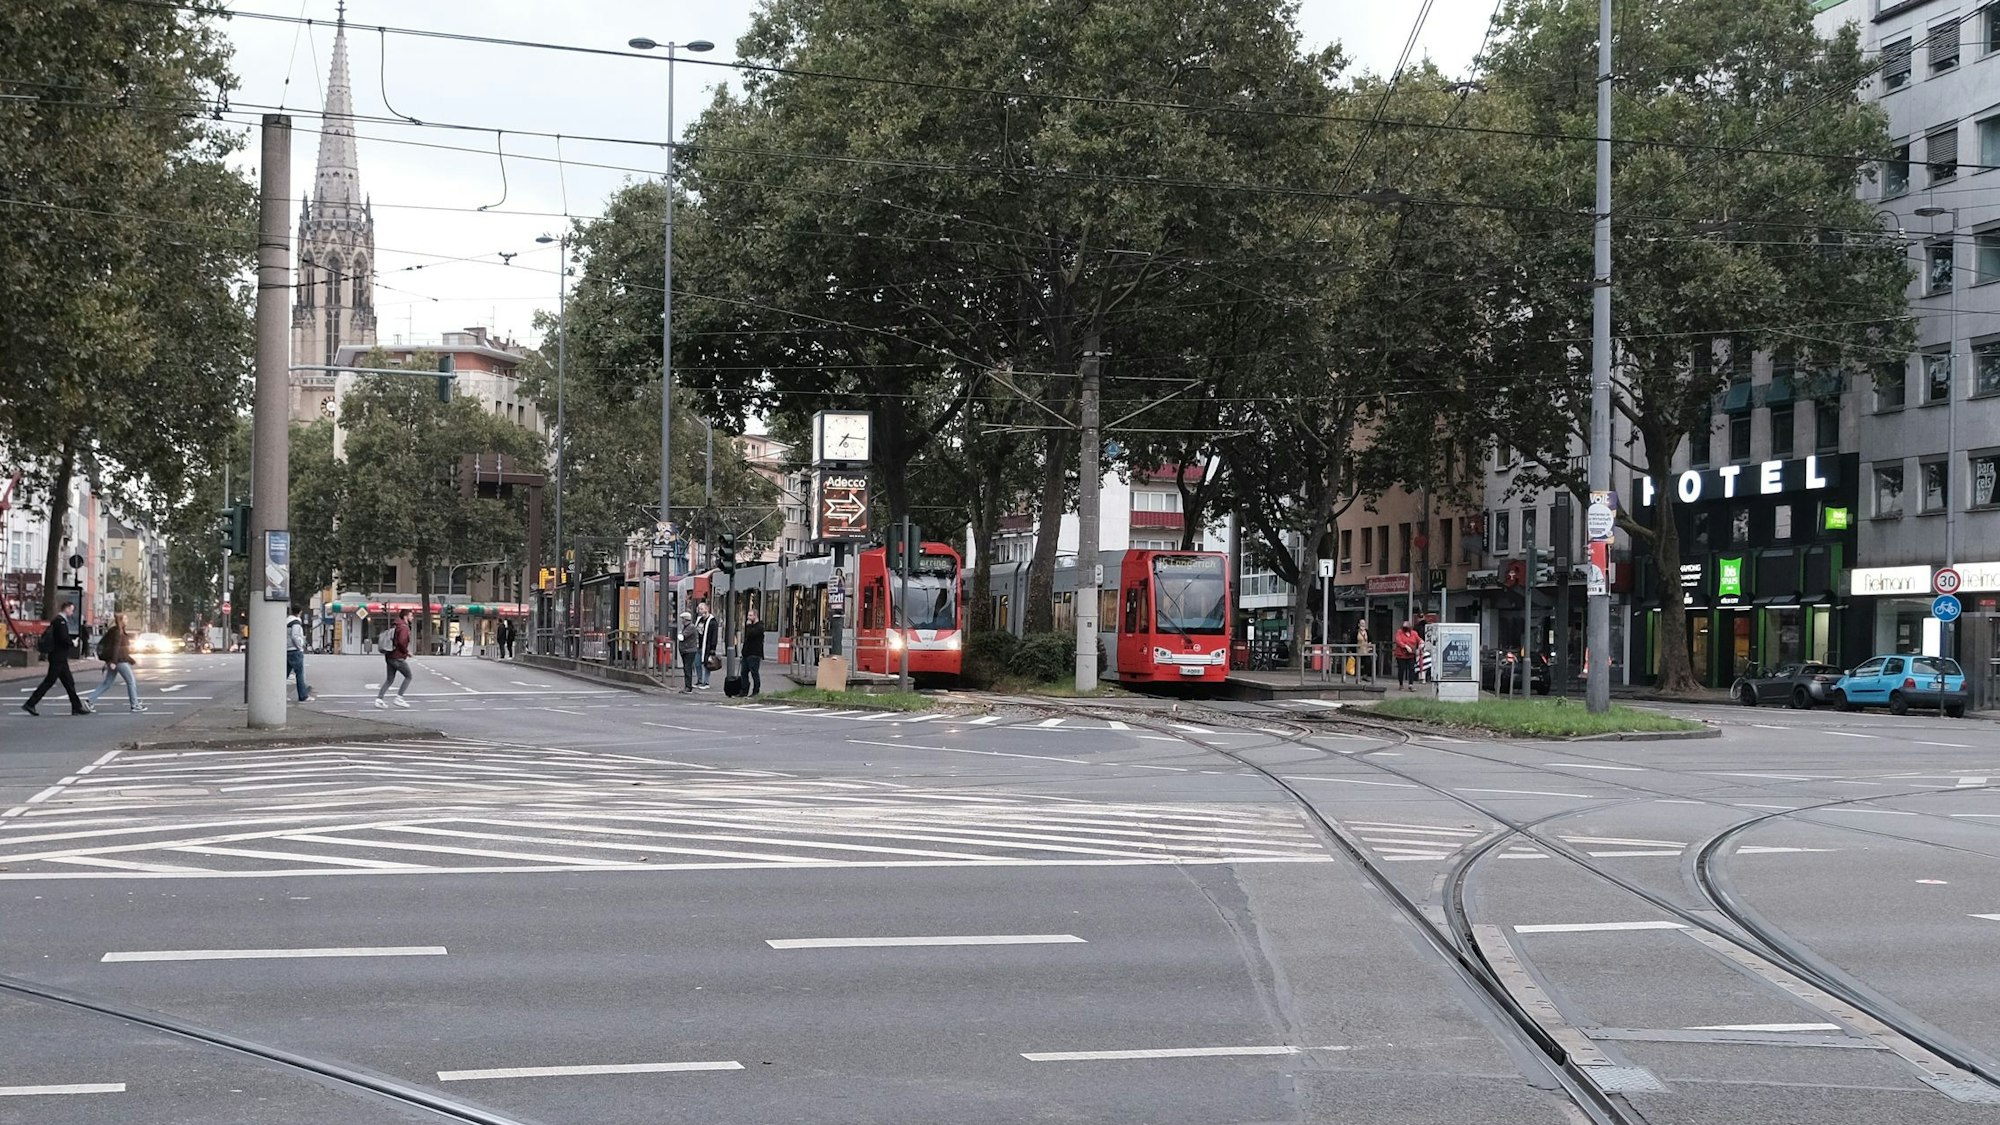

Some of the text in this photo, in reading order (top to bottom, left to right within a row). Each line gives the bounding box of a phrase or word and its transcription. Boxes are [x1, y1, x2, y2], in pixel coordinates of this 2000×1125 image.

[826, 476, 867, 488] Adecco
[1590, 493, 1610, 504] Volt
[1324, 565, 1329, 576] 1
[1864, 572, 1916, 592] fielmann
[1939, 575, 1956, 588] 30
